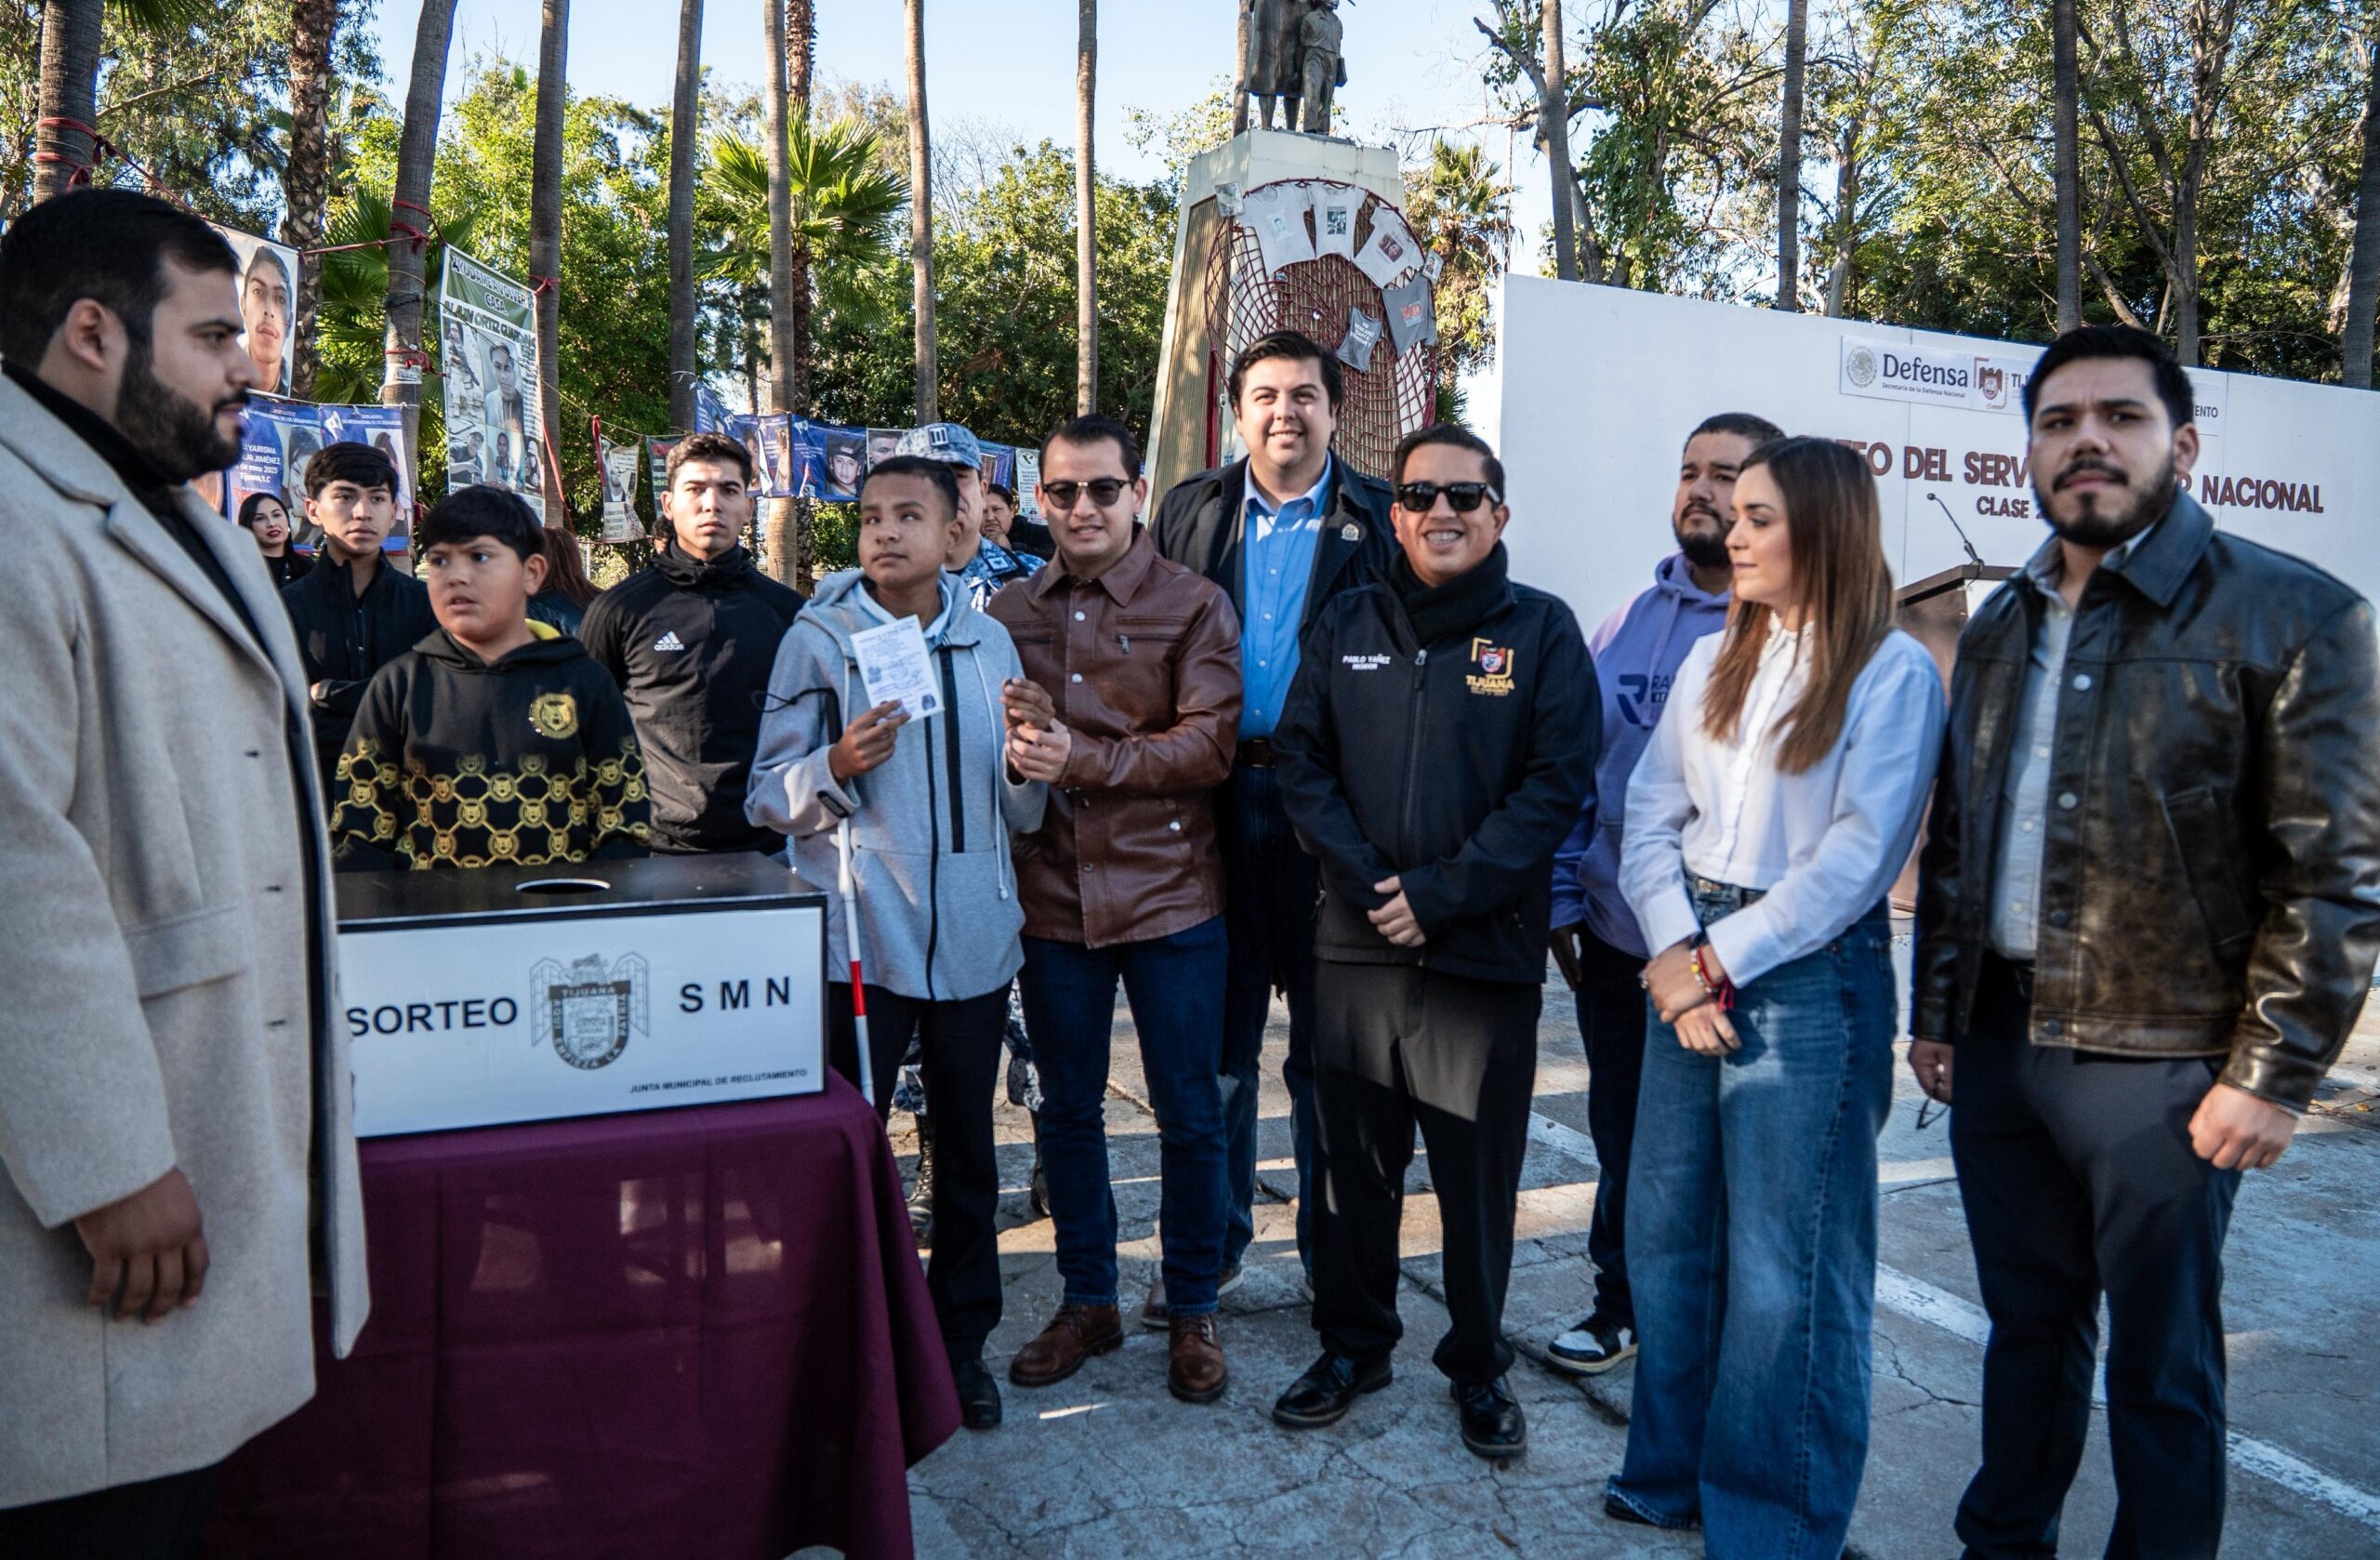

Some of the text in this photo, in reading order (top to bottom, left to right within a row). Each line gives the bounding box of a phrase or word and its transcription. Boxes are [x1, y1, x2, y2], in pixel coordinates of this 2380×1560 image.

[1882, 353, 1968, 388] Defensa
[2193, 405, 2218, 418] ENTO
[1904, 446, 1952, 482] DEL
[1964, 451, 2033, 489] SERV
[2202, 474, 2323, 513] NACIONAL
[1977, 496, 2029, 519] CLASE
[654, 642, 685, 651] adidas
[1465, 674, 1515, 690] TIJUANA
[562, 986, 615, 998] TIJUANA
[680, 975, 790, 1013] S M N
[345, 996, 518, 1038] SORTEO
[629, 1068, 808, 1094] JUNTA MUNICIPAL DE RECLUTAMIENTO
